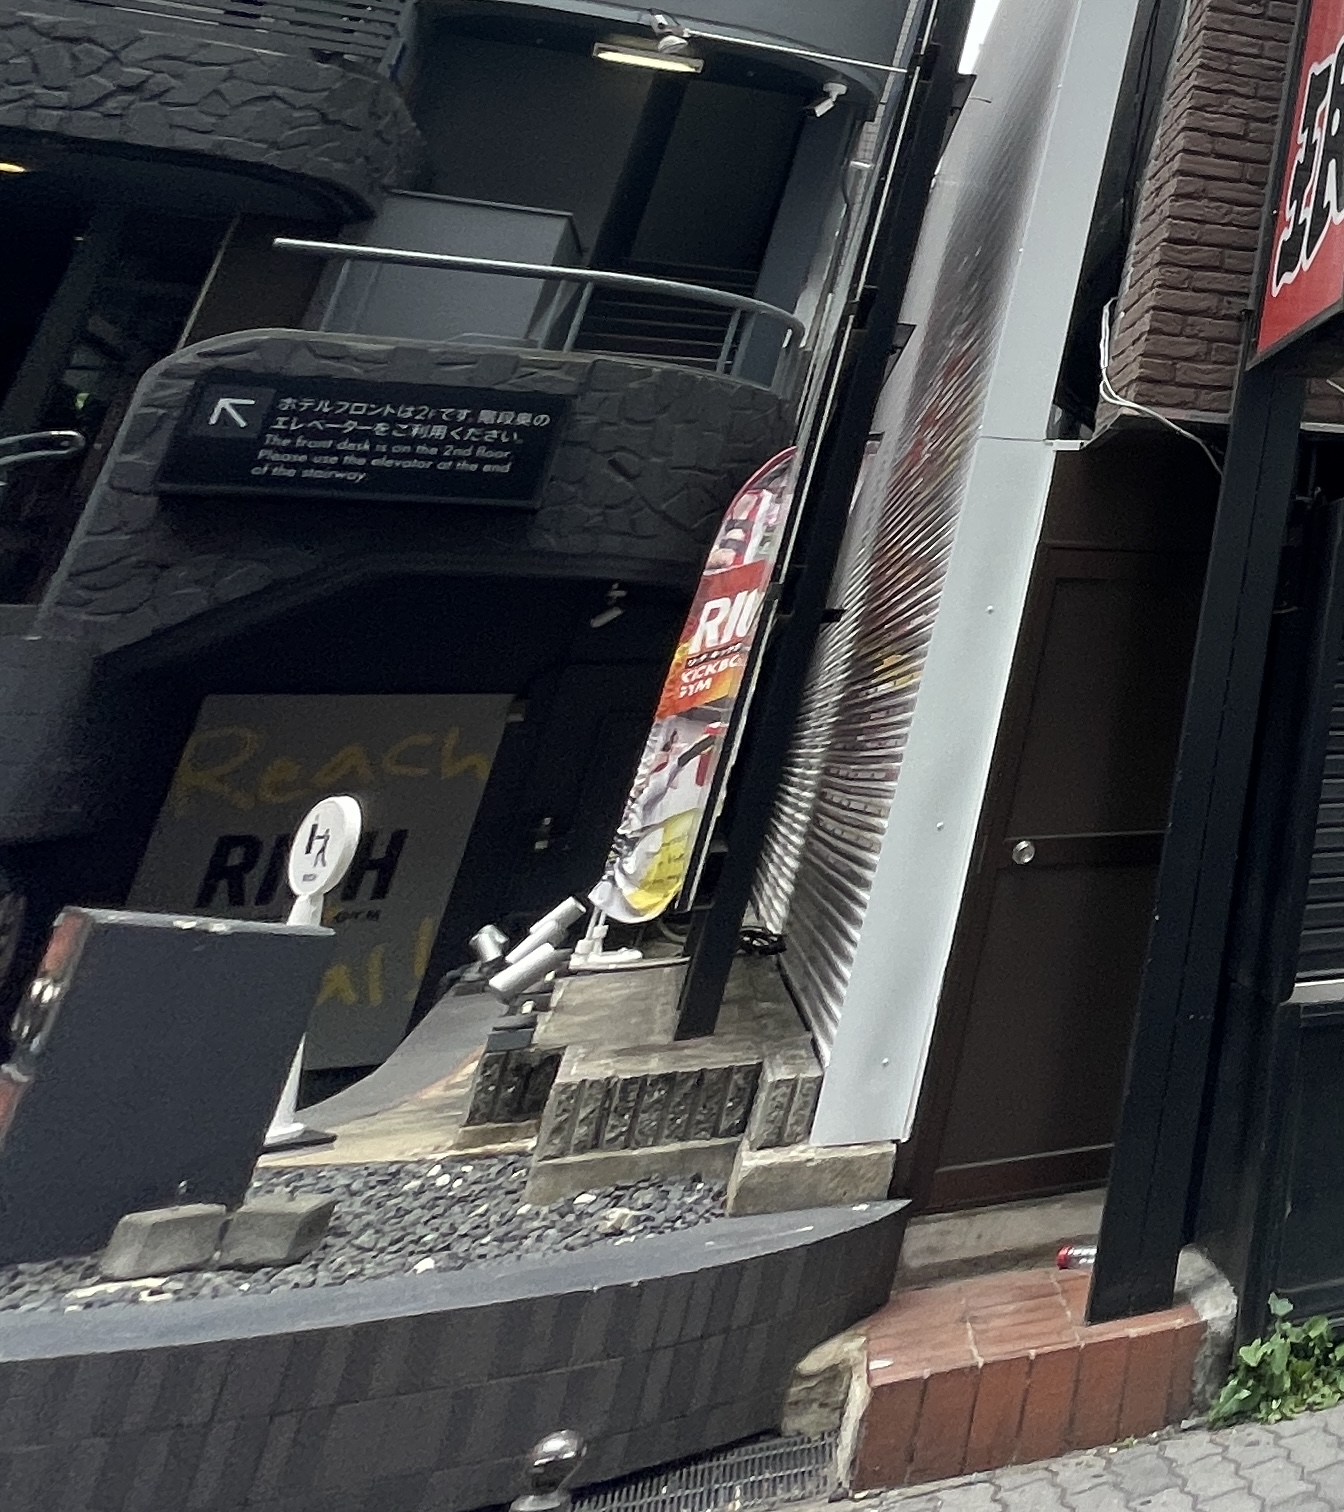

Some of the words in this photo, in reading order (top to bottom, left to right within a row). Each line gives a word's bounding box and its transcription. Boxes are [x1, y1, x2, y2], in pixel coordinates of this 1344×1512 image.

[391, 443, 412, 454] on
[415, 442, 440, 456] the
[442, 444, 474, 459] 2nd
[270, 465, 297, 478] the
[312, 454, 340, 465] use
[342, 453, 367, 466] the
[370, 455, 435, 471] elevator
[454, 460, 478, 472] the
[481, 461, 512, 474] end
[194, 828, 409, 908] RIH
